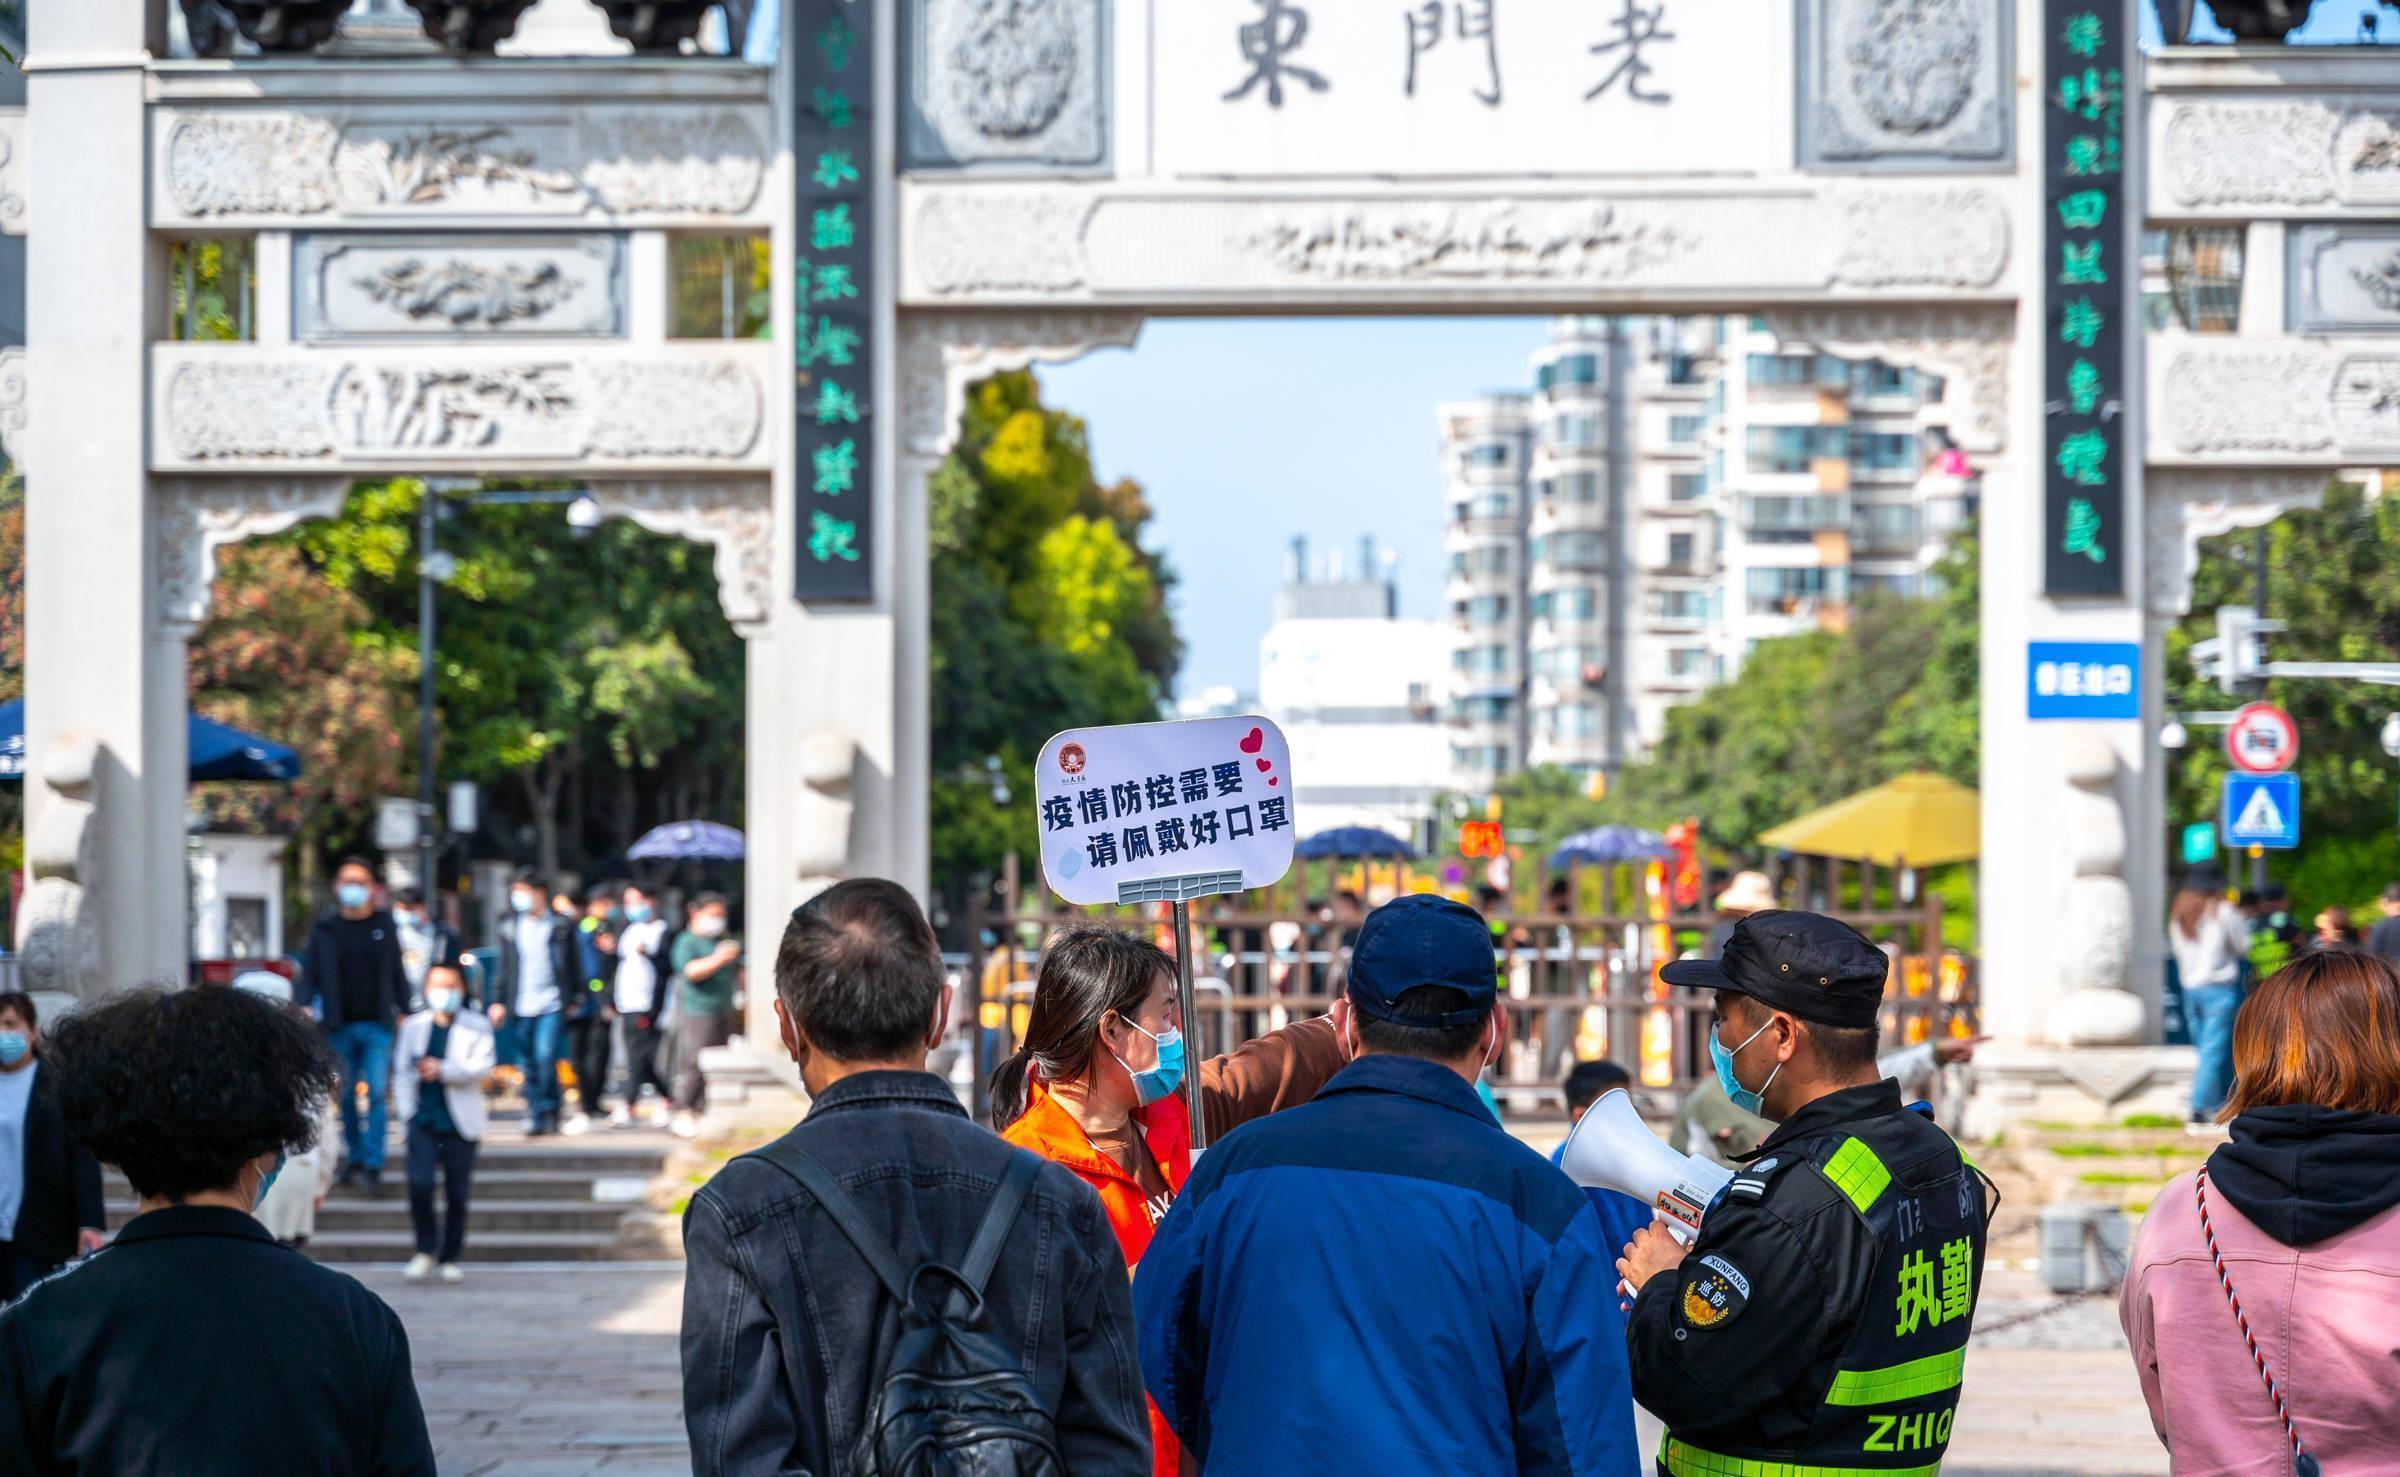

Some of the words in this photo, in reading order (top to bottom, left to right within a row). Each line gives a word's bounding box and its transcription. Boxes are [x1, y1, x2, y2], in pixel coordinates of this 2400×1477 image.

[1041, 760, 1244, 833] 疫情防控需要
[1086, 796, 1290, 868] 请佩戴好口罩
[1697, 1280, 1727, 1308] 巡防
[1708, 1256, 1749, 1292] XUNFANG
[1895, 1234, 1973, 1338] 执勤
[1862, 1407, 1953, 1452] ZHIQ
